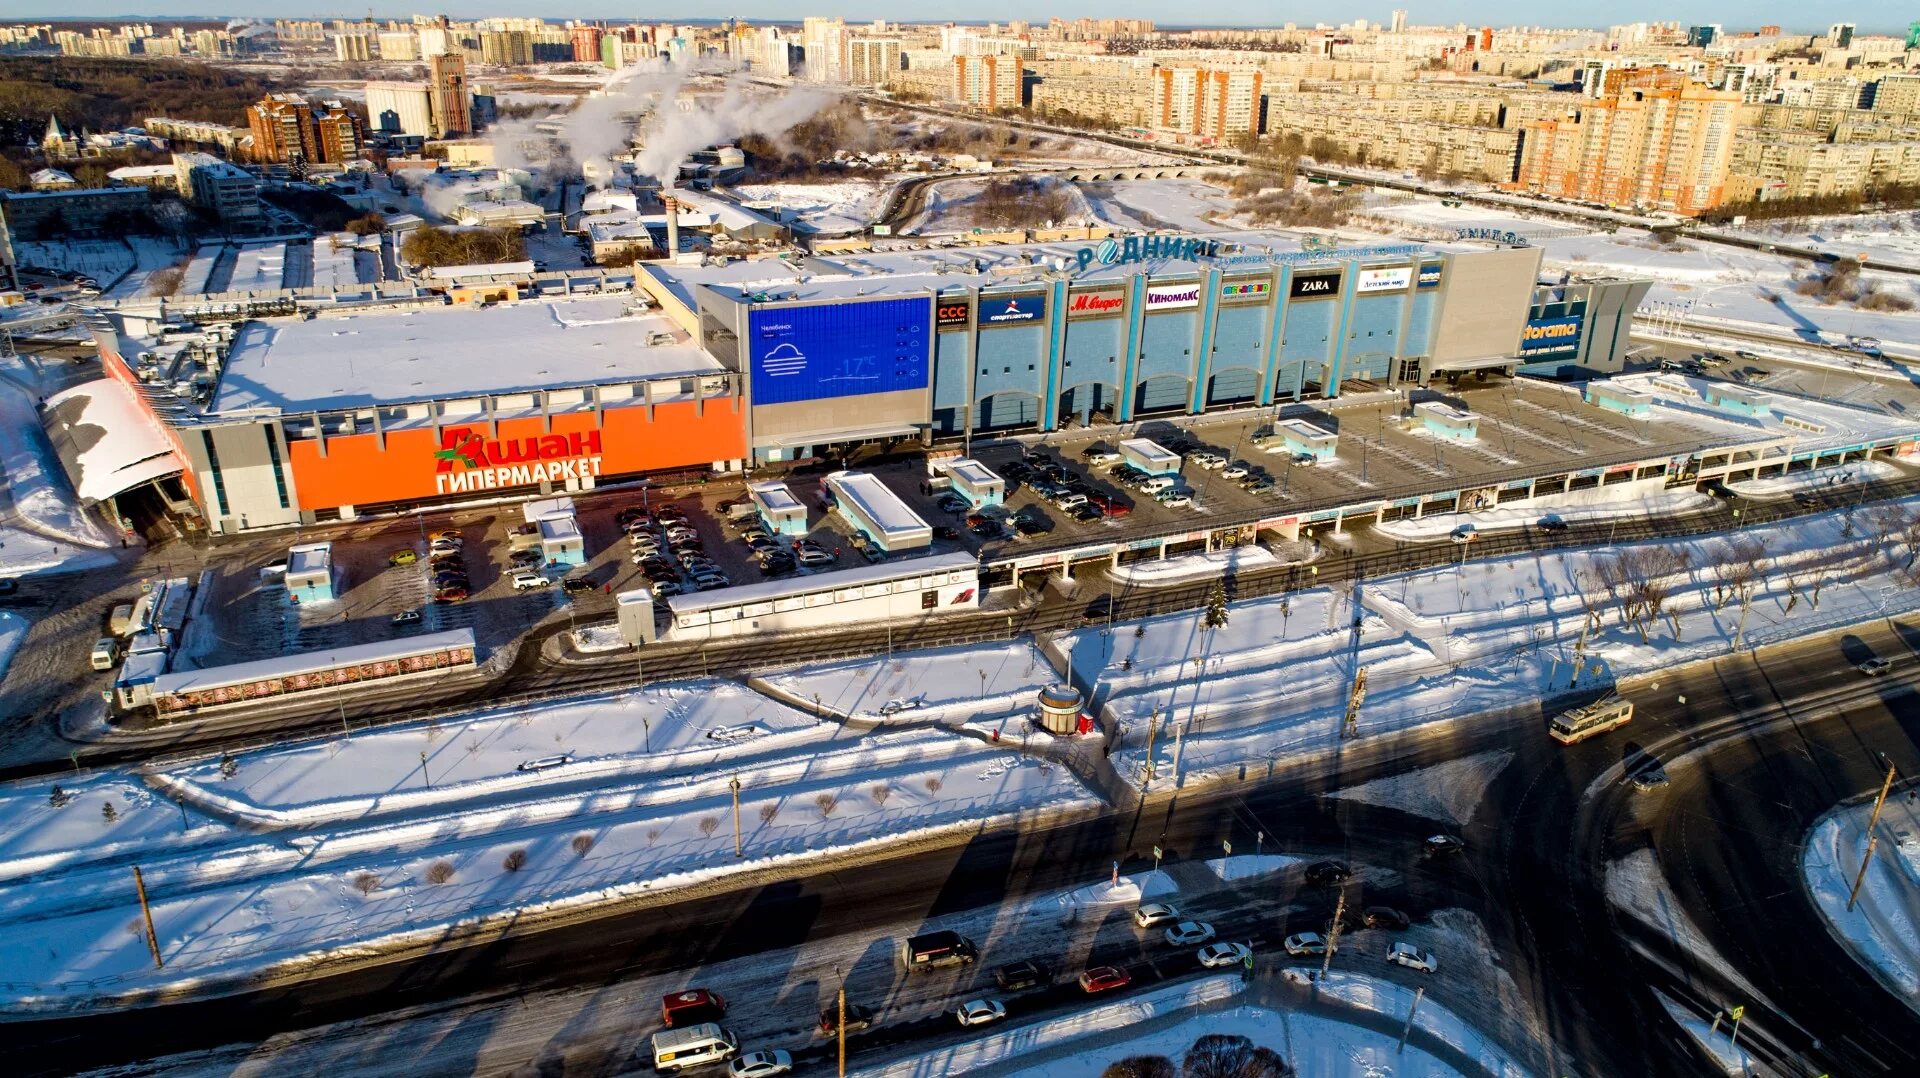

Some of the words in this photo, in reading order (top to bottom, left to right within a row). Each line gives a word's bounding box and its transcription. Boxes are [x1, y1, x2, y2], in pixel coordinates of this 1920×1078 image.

[1301, 280, 1330, 291] ZARA
[1070, 295, 1123, 312] М.видео
[938, 306, 966, 318] CCC
[436, 456, 602, 495] ГИПЕРМАРКЕТ
